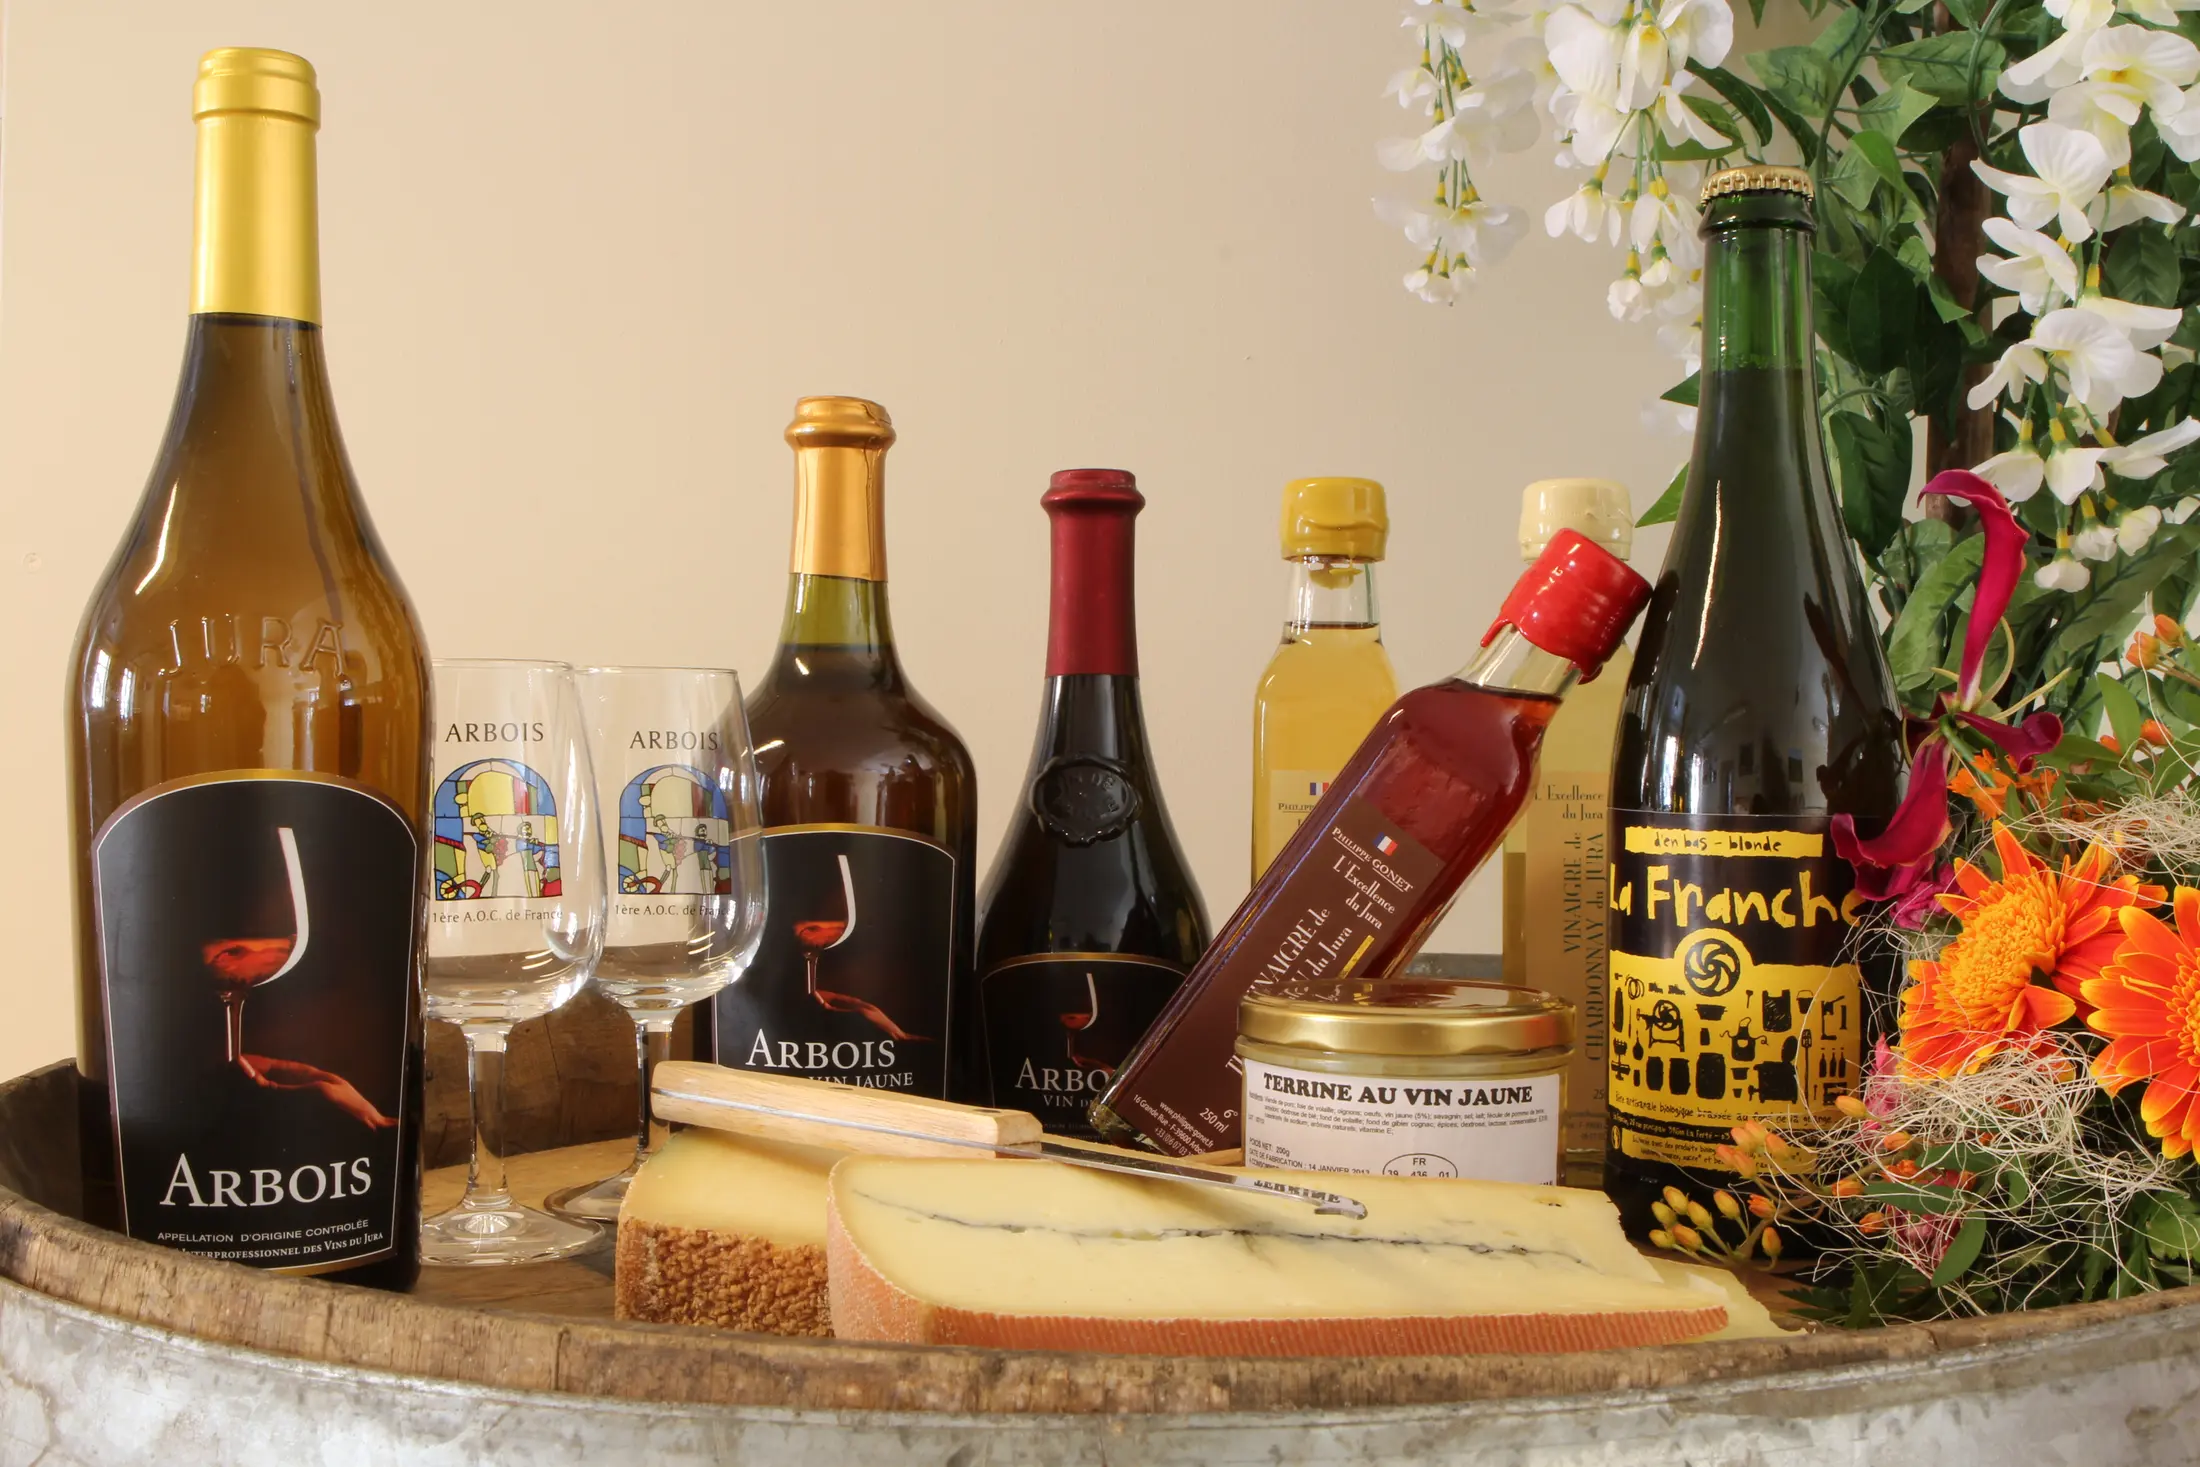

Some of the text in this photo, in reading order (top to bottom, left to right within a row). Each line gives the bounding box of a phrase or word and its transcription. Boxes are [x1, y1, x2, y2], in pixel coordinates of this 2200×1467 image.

[157, 611, 347, 678] JURA
[445, 722, 544, 743] ARBOIS
[630, 730, 718, 750] ARBOIS
[1562, 803, 1603, 821] du Jura
[1684, 832, 1707, 850] bas
[1729, 836, 1782, 852] blonde
[1332, 827, 1413, 892] PHILIPPE GONET
[1333, 854, 1395, 914] L'Excellence
[1563, 832, 1582, 953] VINAIGRE de
[463, 909, 501, 922] A.O.C.
[505, 908, 521, 921] de
[524, 908, 564, 921] France
[643, 904, 679, 916] A.O.C.
[682, 904, 696, 916] de
[1307, 908, 1330, 926] de
[1345, 891, 1383, 930] du Jura
[1305, 958, 1329, 976] du
[1318, 927, 1353, 960] Jura
[1586, 833, 1606, 1061] CHARDONNAY du JURA
[745, 1028, 896, 1069] ARBOIS
[1015, 1057, 1110, 1092] ARBO
[1263, 1072, 1352, 1104] TERRINE
[1357, 1086, 1397, 1105] AU
[1403, 1087, 1453, 1107] VIN
[1457, 1085, 1533, 1106] JAUNE
[1043, 1095, 1074, 1107] VIN
[1133, 1095, 1142, 1104] 16
[1139, 1099, 1160, 1118] Grande
[1156, 1113, 1169, 1126] Rue
[1660, 1102, 1694, 1119] biologique
[1200, 1107, 1230, 1134] 250 ml
[1223, 1109, 1239, 1119] 6°
[1382, 1118, 1389, 1126] de
[1391, 1119, 1408, 1128] gibier
[1395, 1111, 1413, 1119] jaune
[1265, 1154, 1303, 1169] FABRICATION
[1275, 1146, 1290, 1157] 200g
[1412, 1157, 1427, 1166] FR
[159, 1152, 372, 1207] ARBOIS
[157, 1232, 234, 1243] APPELLATION
[241, 1230, 302, 1242] D'ORIGINE
[303, 1244, 322, 1254] DES
[324, 1240, 347, 1251] VINS
[349, 1236, 362, 1247] DU
[364, 1232, 384, 1246] JURA
